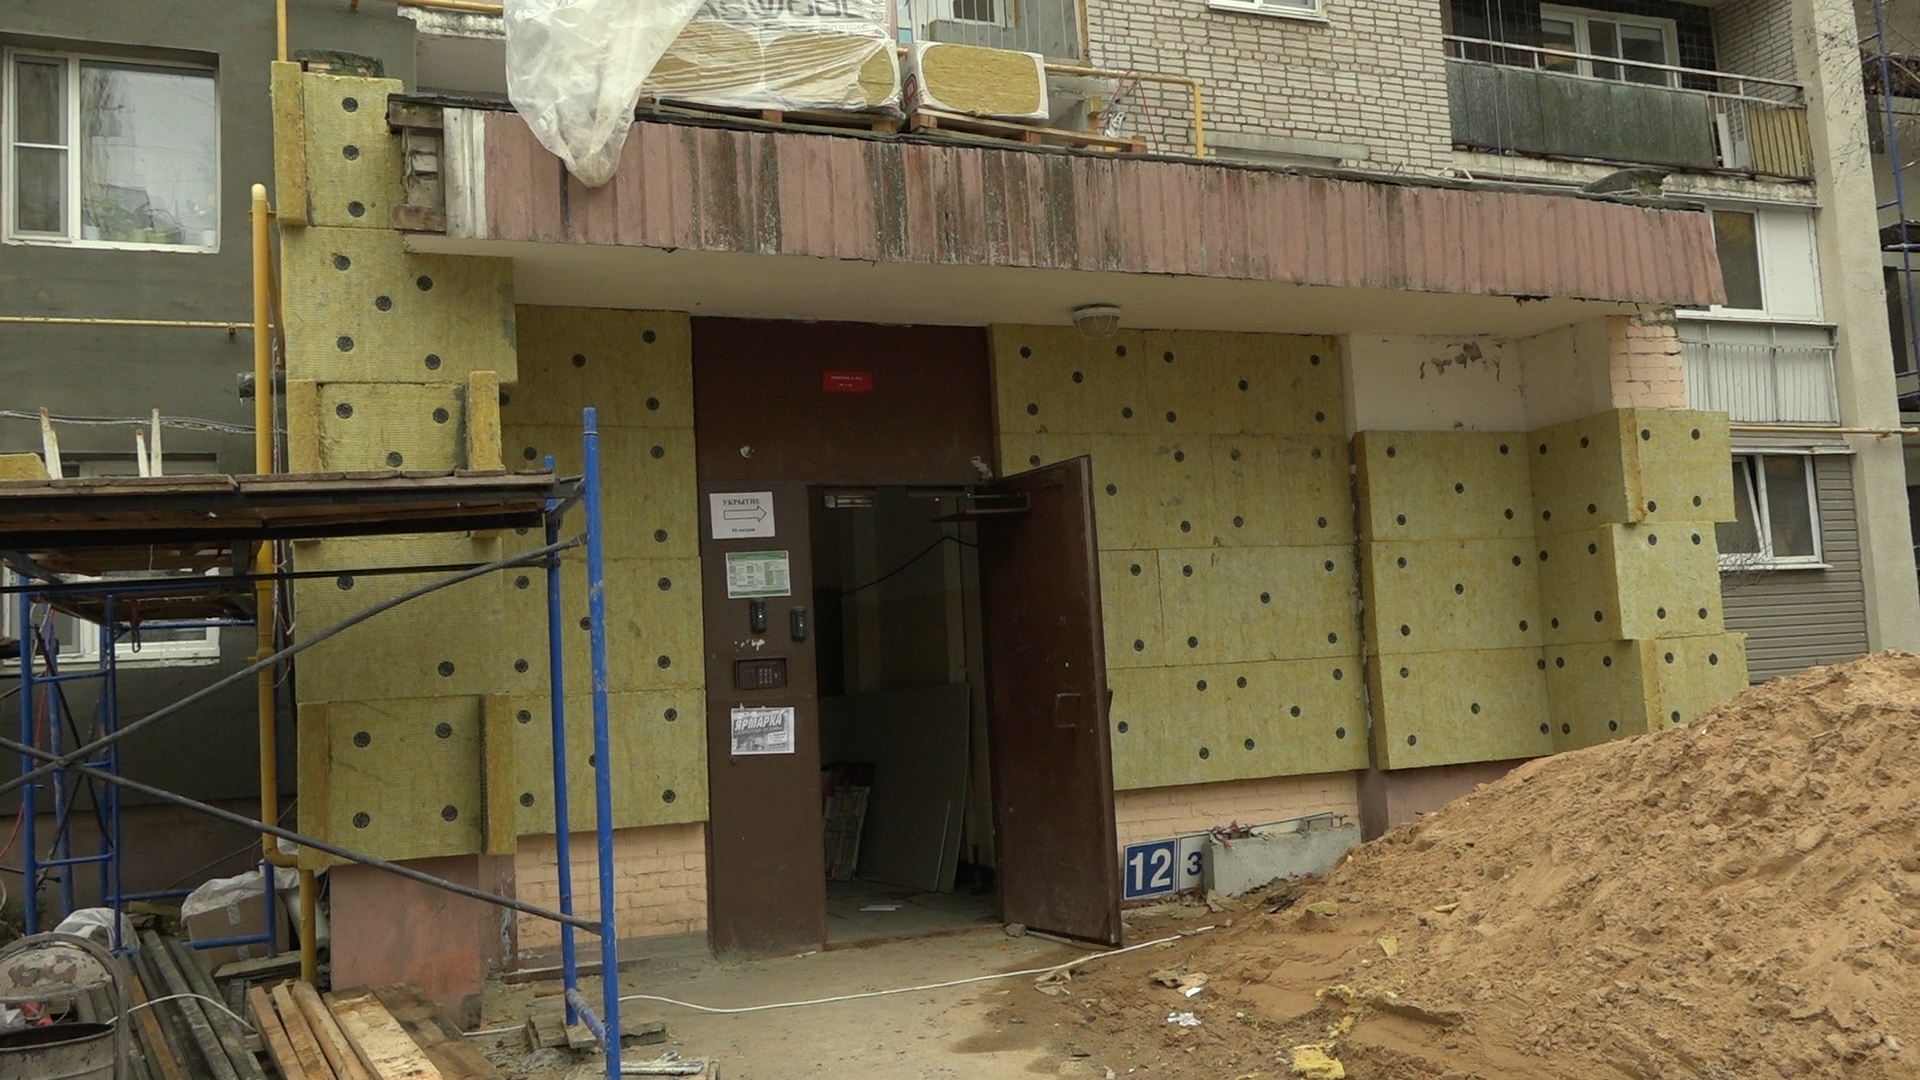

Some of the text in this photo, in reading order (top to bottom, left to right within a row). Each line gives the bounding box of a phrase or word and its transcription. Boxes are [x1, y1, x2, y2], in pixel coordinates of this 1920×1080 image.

[722, 498, 760, 506] УКРЫТИЕ
[734, 714, 783, 731] ЯРМАРКА
[1129, 848, 1172, 891] 12
[1186, 851, 1202, 876] 3
